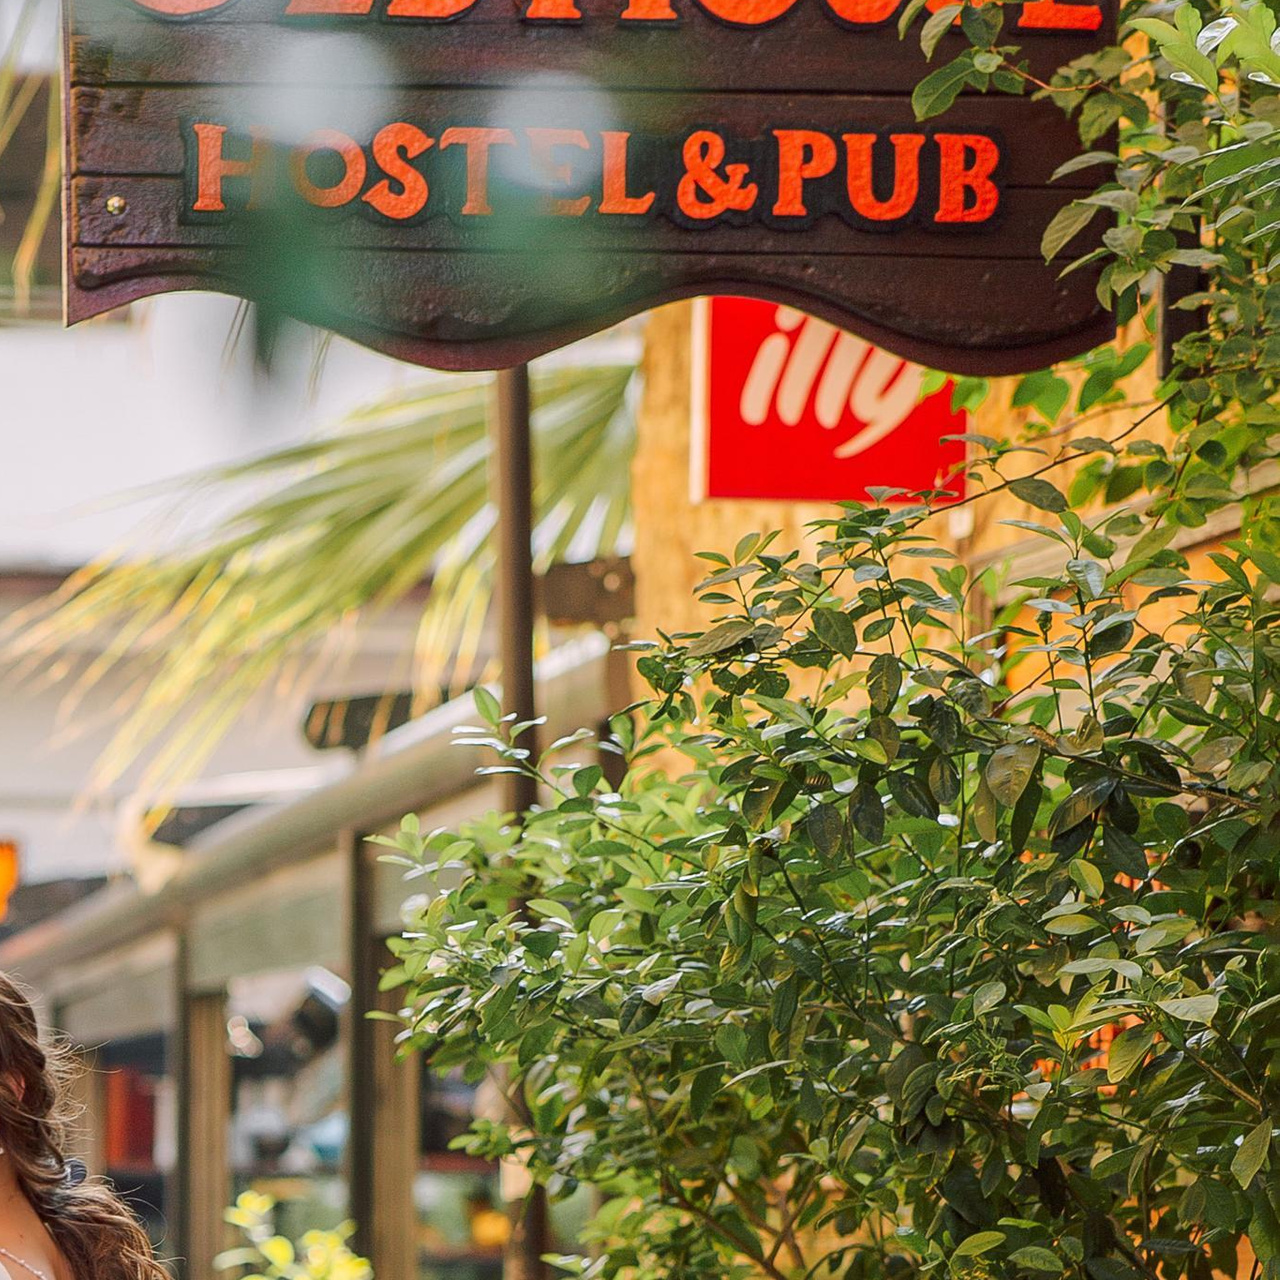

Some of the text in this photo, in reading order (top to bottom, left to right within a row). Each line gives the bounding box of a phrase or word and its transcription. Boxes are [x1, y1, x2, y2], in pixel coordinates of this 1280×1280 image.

[192, 122, 1000, 222] HOSTEL & PUB
[739, 303, 926, 460] illy
